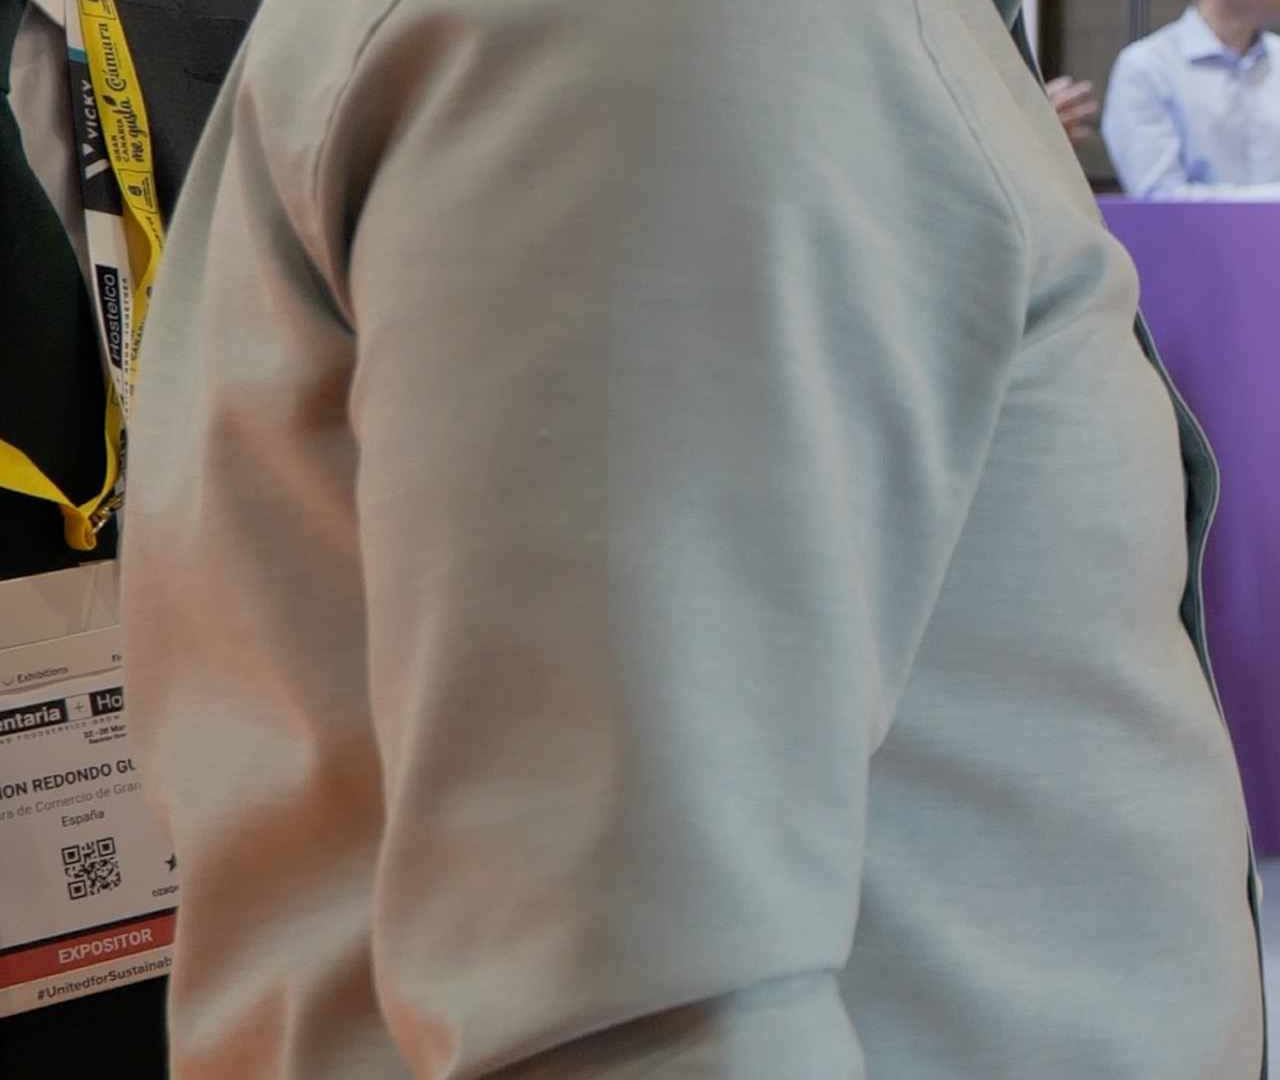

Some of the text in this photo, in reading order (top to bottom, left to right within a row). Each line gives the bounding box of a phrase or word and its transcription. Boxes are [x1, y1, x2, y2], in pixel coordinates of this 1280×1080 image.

[100, 22, 127, 93] Cámara
[85, 78, 99, 140] VICKY
[104, 274, 120, 361] Hostelco
[17, 666, 69, 684] Exhibitions
[97, 693, 123, 710] Ho
[0, 781, 27, 801] ON
[32, 763, 112, 792] REDONDO
[17, 805, 32, 816] de
[35, 790, 93, 813] Comercio
[96, 786, 110, 799] de
[61, 809, 105, 828] España
[58, 928, 153, 964] EXPOSITOR
[37, 956, 172, 1000] #UnitedforSustainab
